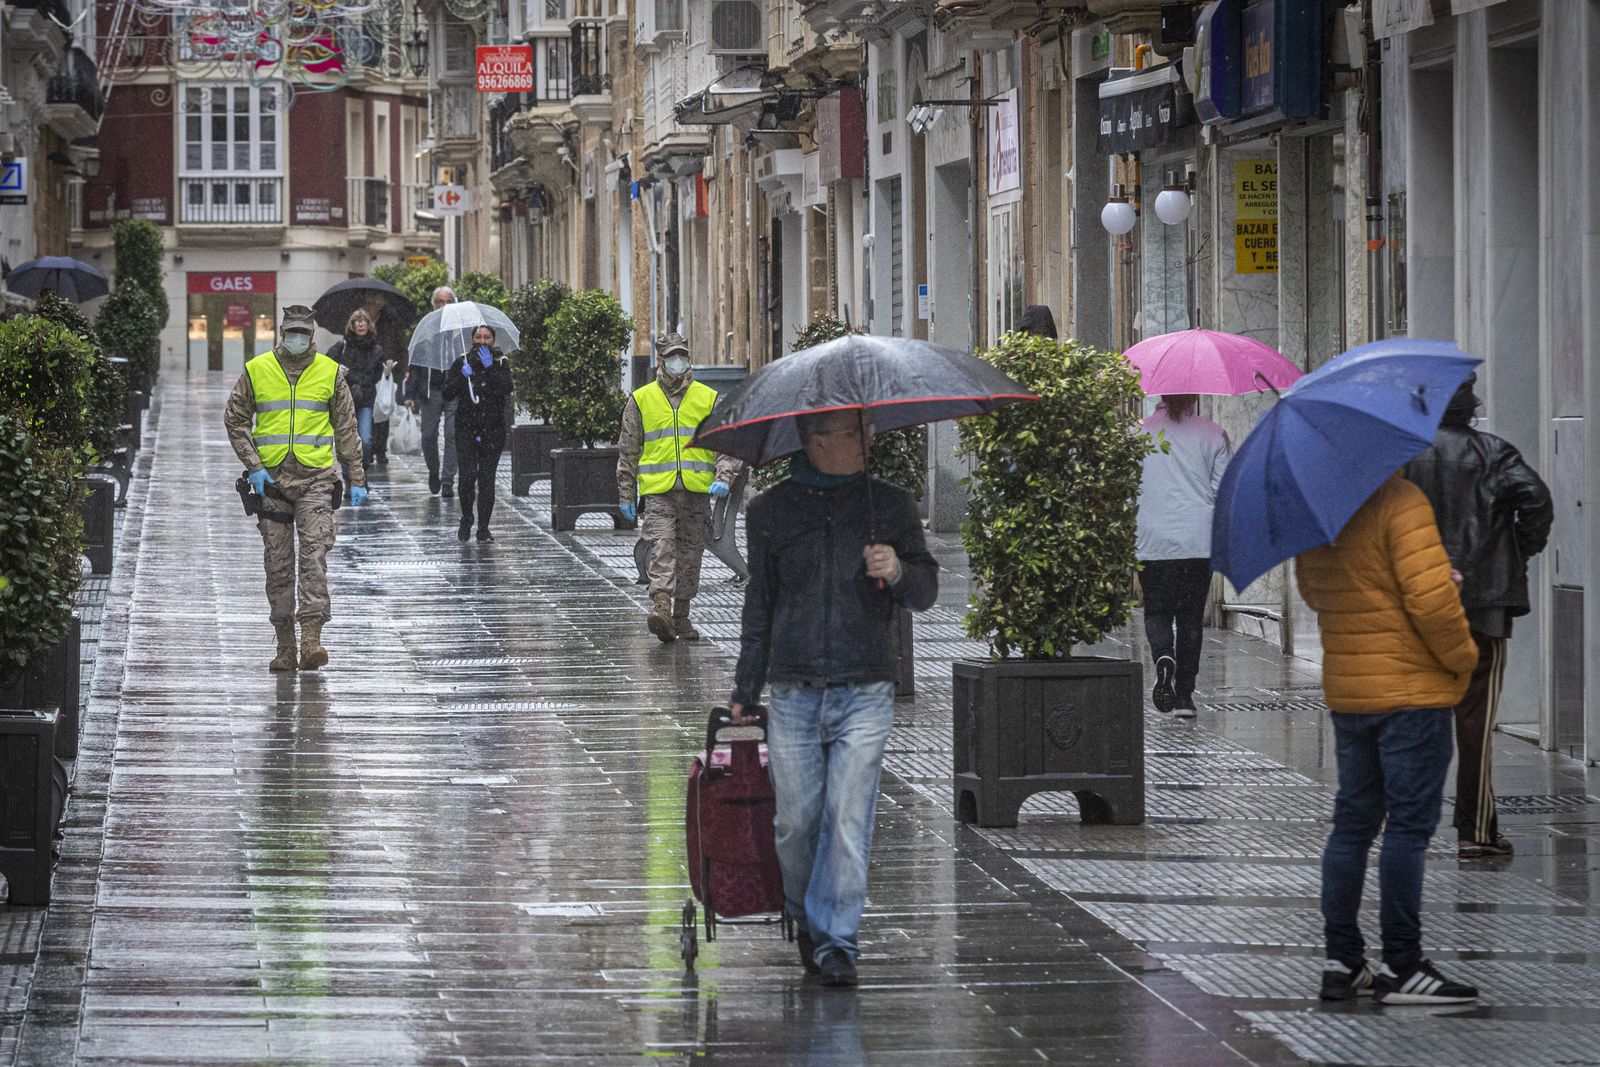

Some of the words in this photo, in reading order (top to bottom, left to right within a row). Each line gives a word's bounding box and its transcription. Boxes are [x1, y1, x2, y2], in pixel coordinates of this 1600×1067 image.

[478, 62, 533, 75] ALQUILA
[478, 75, 533, 89] 956266869
[1242, 182, 1257, 192] EL
[1237, 224, 1269, 235] BAZAR
[1245, 238, 1276, 248] CUERO
[1252, 252, 1257, 262] Y
[210, 276, 253, 291] GAES
